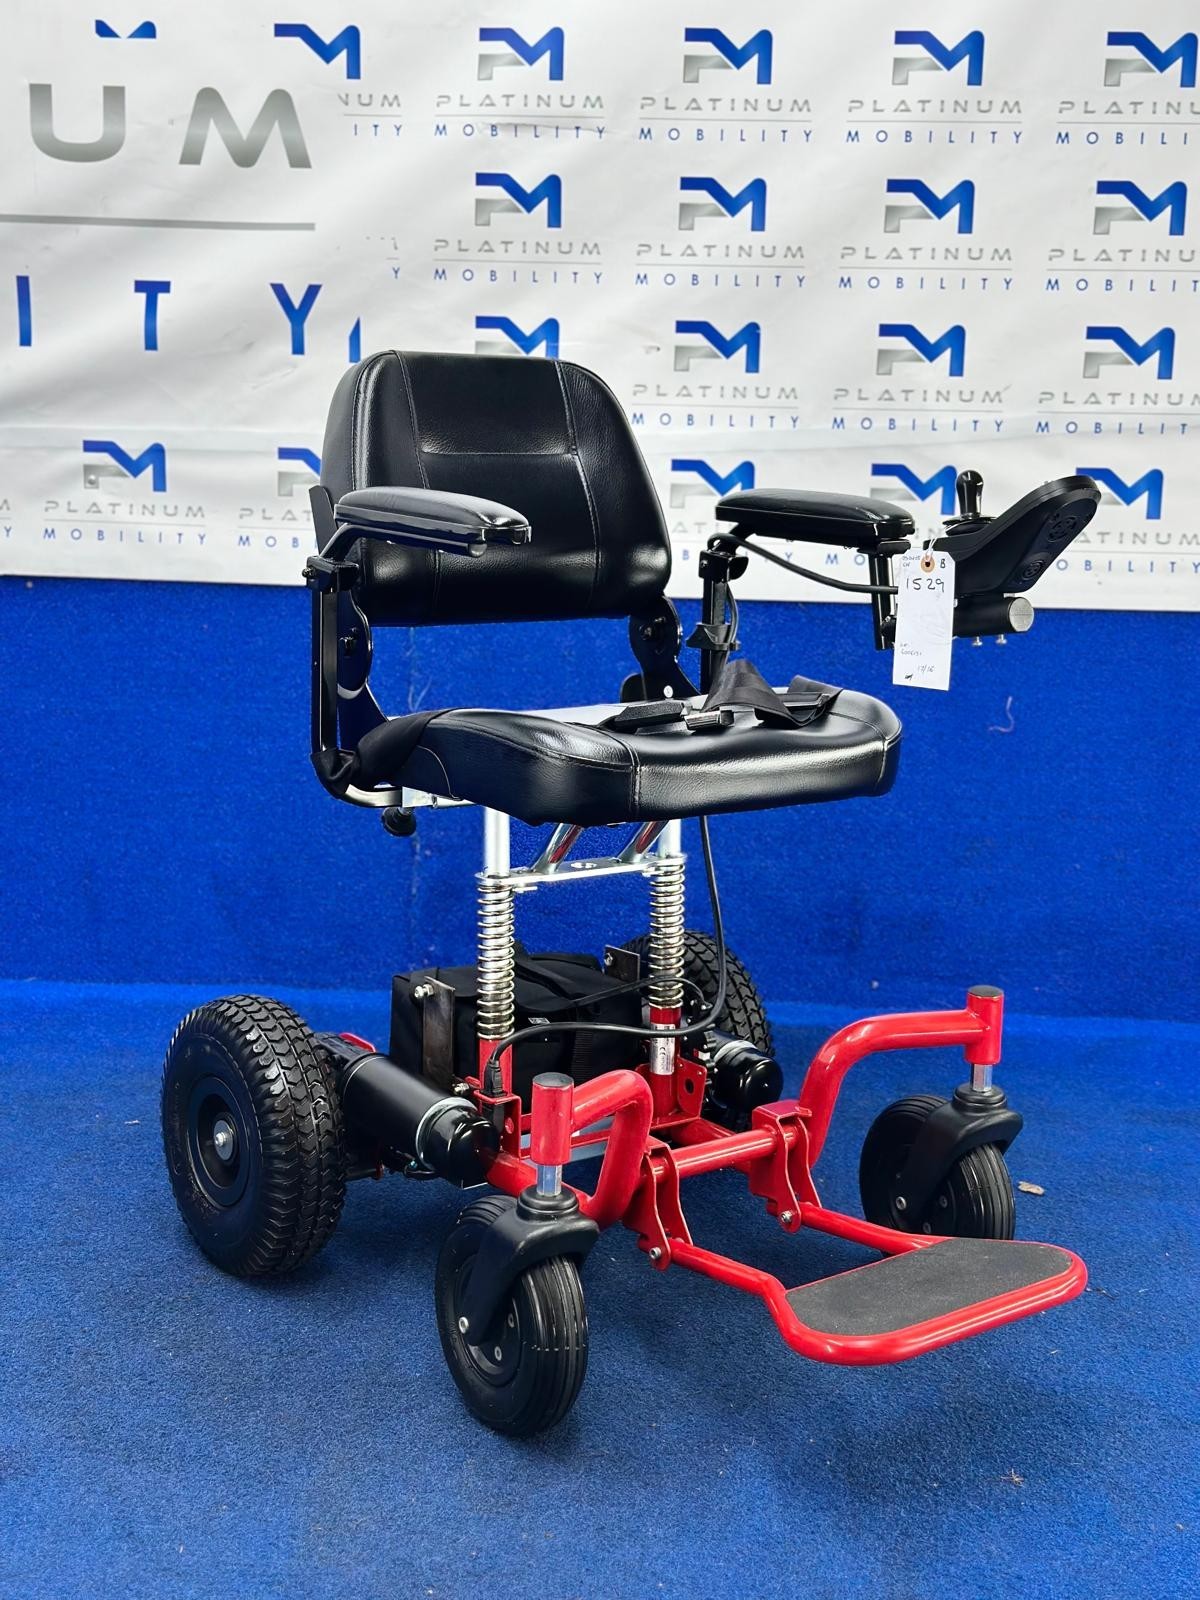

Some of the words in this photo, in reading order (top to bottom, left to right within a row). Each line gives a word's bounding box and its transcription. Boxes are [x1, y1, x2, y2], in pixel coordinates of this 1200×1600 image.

[436, 94, 604, 109] PLATINUM
[640, 96, 811, 112] PLATINUM
[848, 99, 1022, 114] PLATINUM
[435, 123, 605, 140] MOBILITY
[639, 128, 811, 142] MOBILITY
[846, 130, 1022, 145] MOBILITY
[434, 239, 600, 255] PLATINUM
[637, 244, 805, 259] PLATINUM
[840, 246, 1012, 261] PLATINUM
[434, 269, 602, 284] MOBILITY
[635, 273, 804, 287] MOBILITY
[838, 275, 1012, 290] MOBILITY
[633, 384, 798, 400] PLATINUM
[834, 388, 1002, 403] PLATINUM
[632, 414, 798, 428] MOBILITY
[832, 417, 1002, 432] MOBILITY
[44, 501, 205, 518] PLATINUM
[43, 528, 206, 546] MOBILITY
[906, 577, 945, 593] 1529
